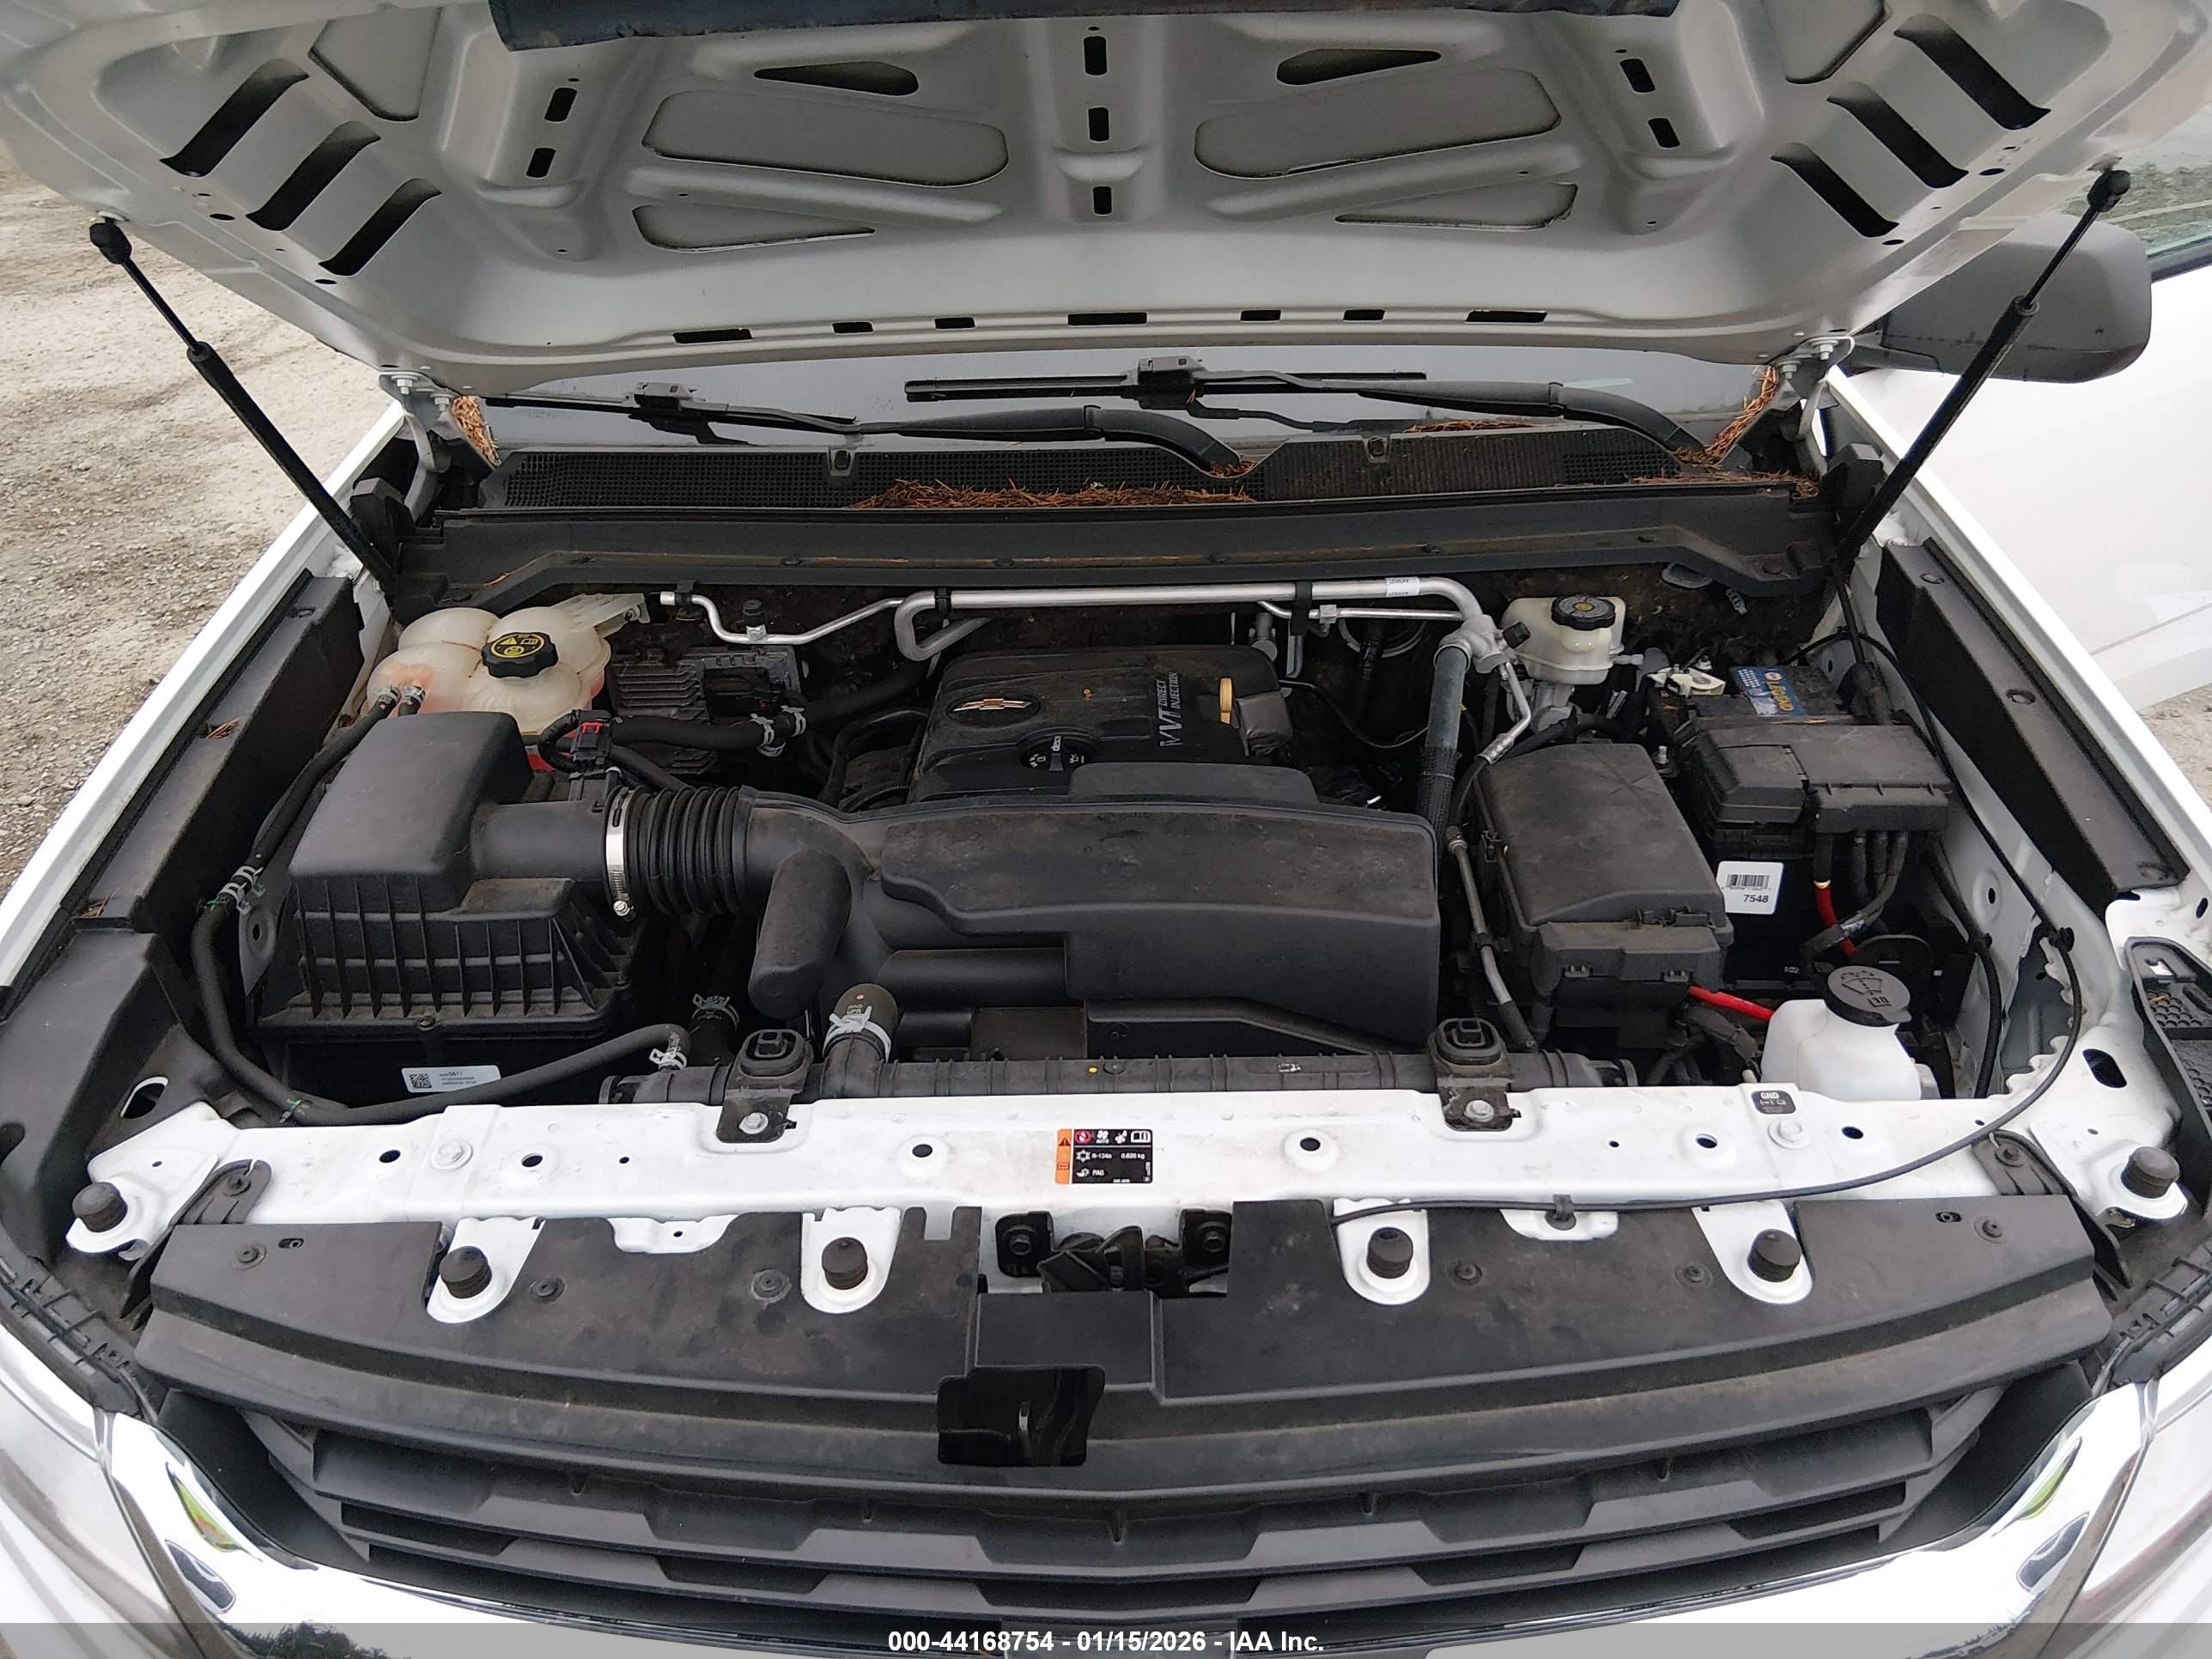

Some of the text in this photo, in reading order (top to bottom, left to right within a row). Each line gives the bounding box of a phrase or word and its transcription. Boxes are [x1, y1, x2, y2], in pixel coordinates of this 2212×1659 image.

[1157, 679, 1168, 707] DIRECT
[1169, 672, 1181, 709] INJECTION
[1743, 894, 1769, 903] 7548
[1760, 1091, 1780, 1100] GND
